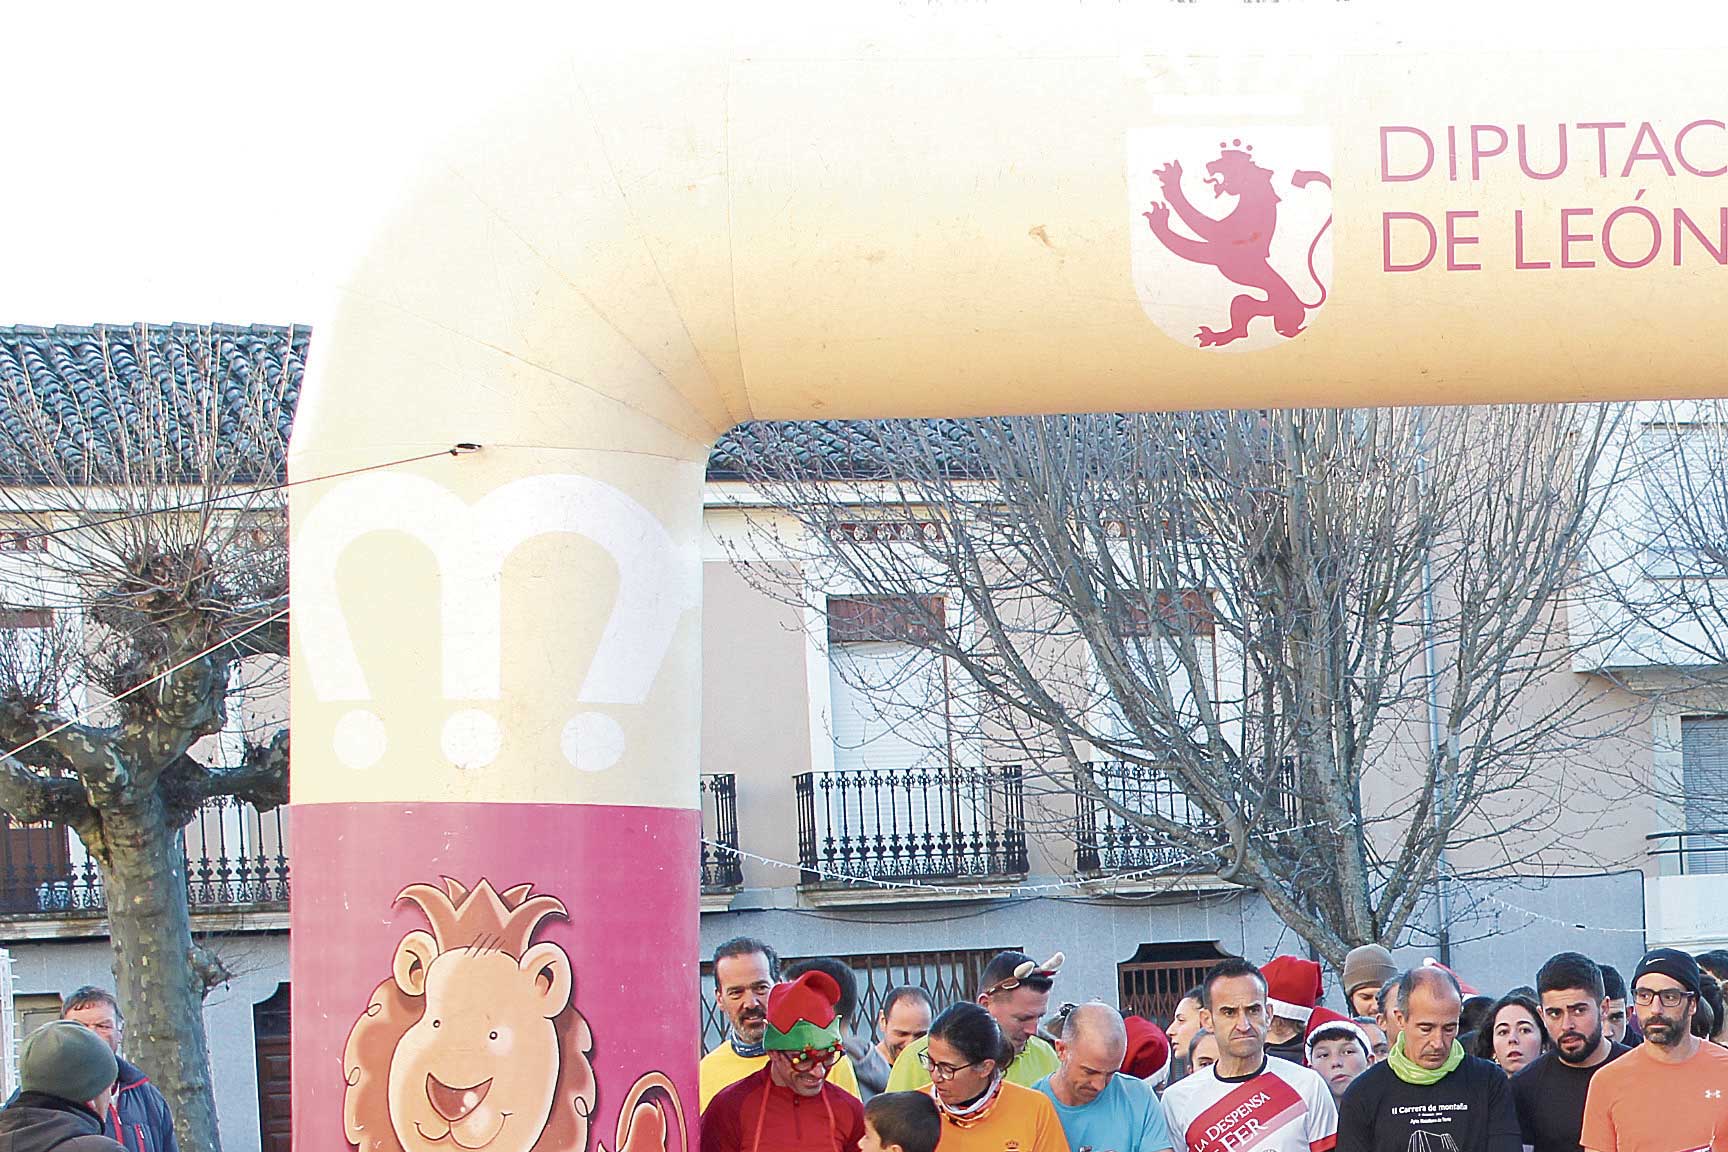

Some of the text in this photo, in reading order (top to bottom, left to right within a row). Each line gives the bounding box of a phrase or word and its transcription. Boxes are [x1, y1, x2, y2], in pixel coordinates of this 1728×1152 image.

[1382, 188, 1728, 273] DE LEÓN
[1205, 1090, 1271, 1142] DESPENSA
[1398, 1104, 1427, 1114] Carrera
[1427, 1104, 1437, 1112] de
